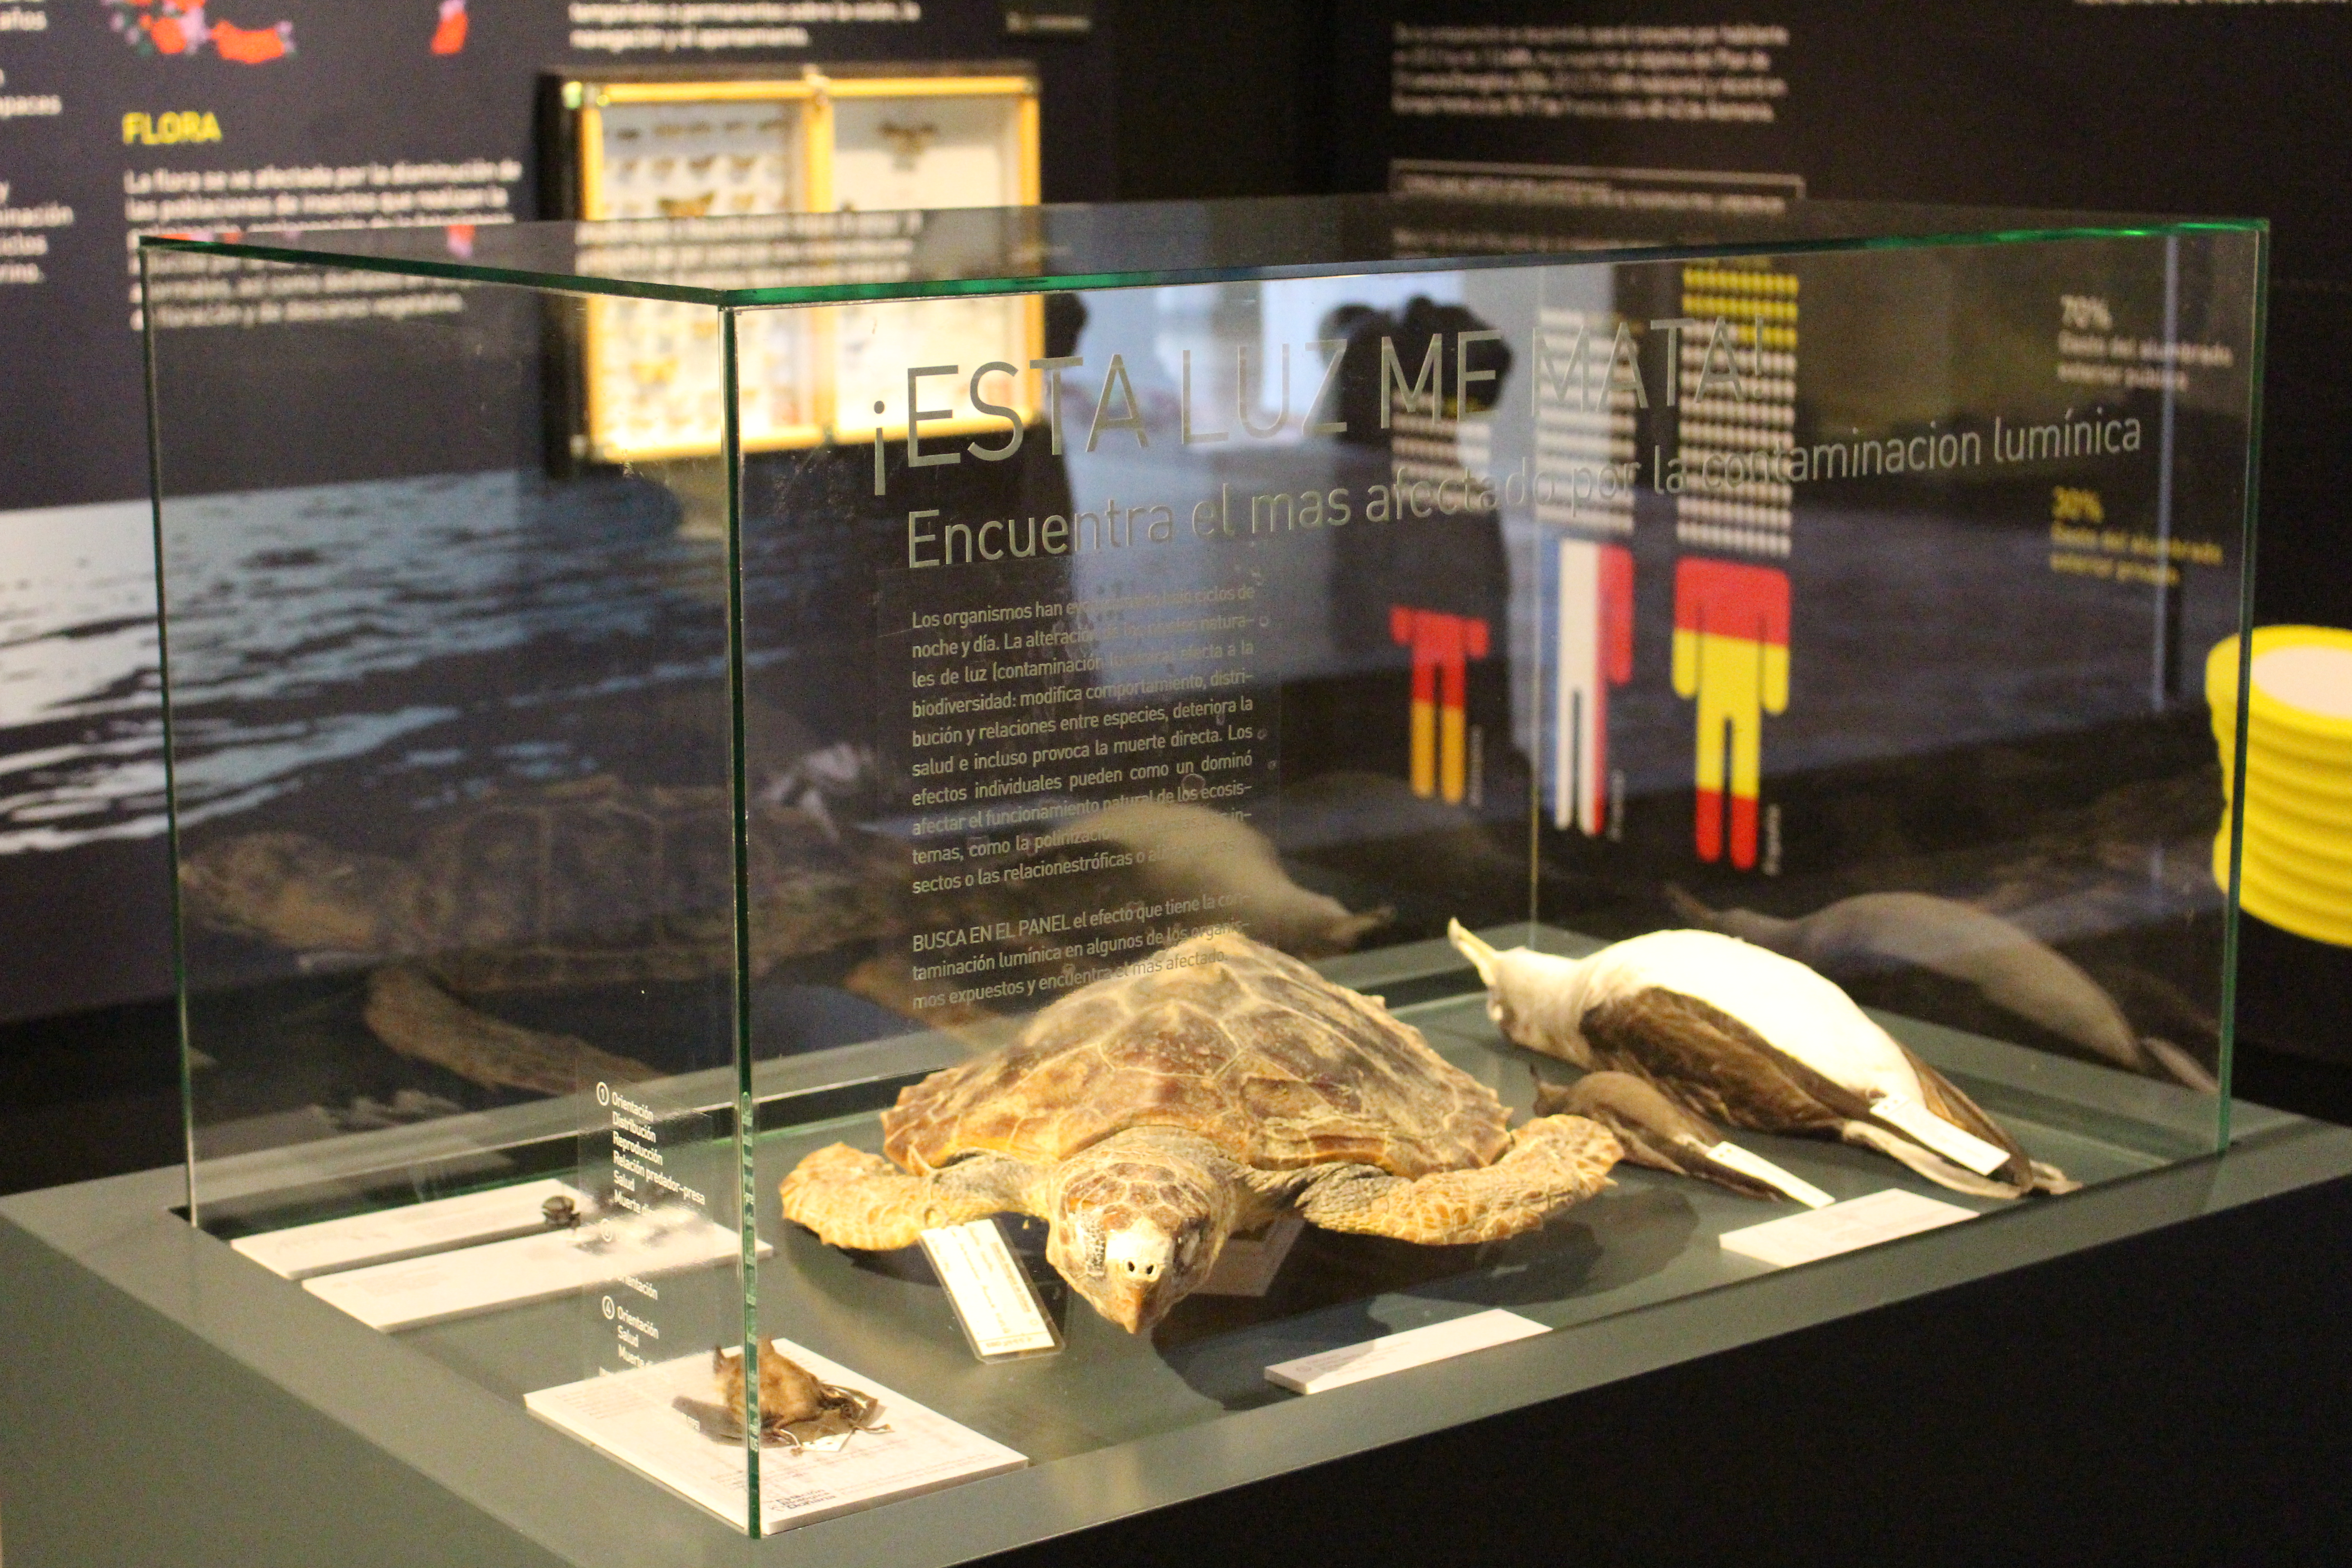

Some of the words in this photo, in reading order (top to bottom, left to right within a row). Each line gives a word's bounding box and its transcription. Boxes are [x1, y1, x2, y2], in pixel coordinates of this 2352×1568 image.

[122, 111, 222, 144] FLORA
[874, 354, 1149, 495] ¡ESTA
[1181, 339, 1347, 445] LUZ
[1381, 329, 1501, 429] ME
[1532, 313, 1764, 416] MATA!
[909, 499, 1173, 568] Encuentra
[1192, 483, 1234, 536] el
[1251, 488, 1351, 534] mas
[1366, 456, 1555, 523] afectado
[1571, 461, 1642, 518] por
[1654, 445, 1687, 495] la
[1701, 421, 1981, 488] contaminacion
[1994, 407, 2141, 463] lumínica
[912, 612, 940, 628] Los
[943, 605, 1032, 628] organismos
[1036, 602, 1062, 617] han
[912, 638, 957, 658] noche
[961, 641, 970, 658] y
[973, 634, 999, 652] día.
[1004, 632, 1021, 649] La
[1026, 628, 1095, 647] alteración
[912, 671, 934, 688] les
[941, 669, 958, 685] de
[965, 666, 986, 683] luz
[1241, 640, 1254, 655] la
[912, 691, 1016, 717] biodiversidad:
[1021, 687, 1082, 706] modifica
[1211, 667, 1253, 686] distri-
[912, 726, 962, 747] bución
[967, 729, 975, 746] y
[980, 720, 1056, 740] relaciones
[1060, 715, 1098, 730] entre
[1103, 706, 1168, 729] especies,
[1173, 699, 1236, 718] deteriora
[1240, 696, 1253, 711] la
[912, 756, 953, 777] salud
[960, 759, 968, 771] e
[975, 751, 1027, 769] incluso
[1033, 745, 1089, 767] provoca
[1096, 740, 1107, 755] la
[1114, 735, 1166, 753] muerte
[1171, 730, 1222, 747] directa.
[1228, 725, 1253, 740] Los
[912, 788, 967, 805] efectos
[975, 775, 1061, 799] individuales
[1070, 768, 1122, 792] pueden
[1130, 764, 1169, 780] como
[1176, 761, 1194, 774] un
[1201, 750, 1252, 771] dominó
[912, 816, 966, 835] afectar
[969, 812, 981, 828] el
[986, 799, 1099, 826] funcionamiento
[1157, 788, 1173, 804] de
[1177, 786, 1197, 801] los
[1200, 780, 1252, 799] ecosis-
[912, 848, 964, 864] temas,
[969, 841, 1009, 857] como
[1016, 835, 1029, 851] la
[912, 876, 961, 893] sectos
[965, 874, 973, 887] o
[978, 869, 1000, 884] las
[1004, 853, 1132, 882] relacionestróficas
[1137, 853, 1144, 866] o
[912, 929, 967, 951] BUSCA
[970, 926, 992, 943] EN
[996, 922, 1015, 939] EL
[1019, 915, 1070, 936] PANEL
[1073, 911, 1086, 929] el
[1090, 906, 1133, 926] efecto
[1137, 906, 1162, 923] que
[1166, 898, 1199, 914] tiene
[1203, 894, 1215, 909] la
[912, 955, 995, 980] taminación
[999, 946, 1061, 968] lumínica
[1066, 944, 1083, 958] en
[1087, 936, 1143, 957] algunos
[1147, 931, 1163, 946] de
[1167, 927, 1187, 942] los
[912, 994, 946, 1009] mos
[949, 982, 1024, 1007] expuestos
[1027, 980, 1035, 995] y
[1133, 961, 1163, 976] mas
[1166, 950, 1228, 970] afectado.
[612, 1092, 653, 1122] Orientación
[612, 1111, 656, 1143] Distribución
[613, 1131, 663, 1166] Reproducción
[613, 1150, 645, 1177] Relación
[646, 1169, 705, 1205] predador-presa
[613, 1170, 635, 1192] Salud
[614, 1189, 640, 1214] Muerte
[617, 1306, 659, 1339] Orientación
[617, 1325, 639, 1348] Salud
